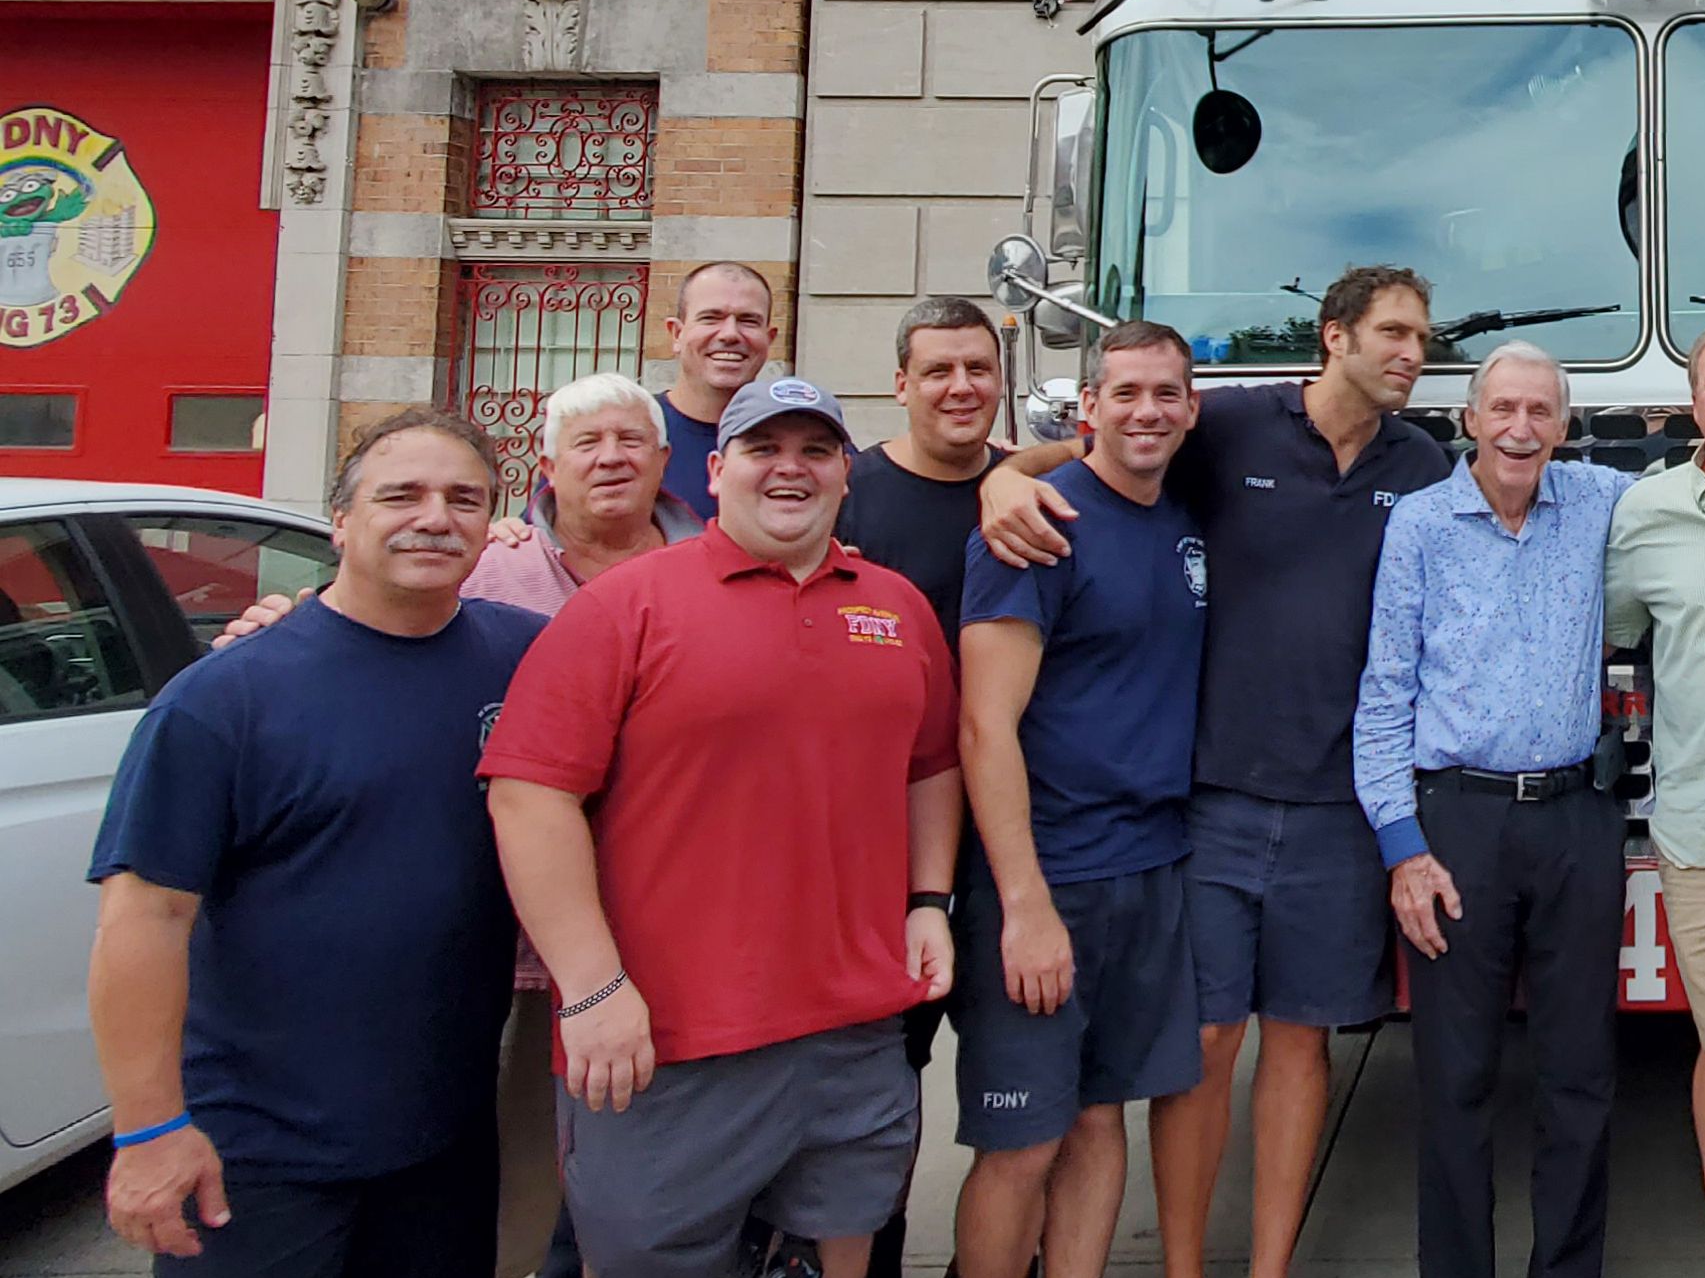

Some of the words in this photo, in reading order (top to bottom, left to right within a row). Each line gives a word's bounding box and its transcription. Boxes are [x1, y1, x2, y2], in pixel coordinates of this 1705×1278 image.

[38, 294, 81, 335] 73
[1245, 476, 1276, 490] FRANK
[1373, 490, 1399, 507] FD
[844, 614, 898, 638] FDNY
[983, 1090, 1030, 1109] FDNY
